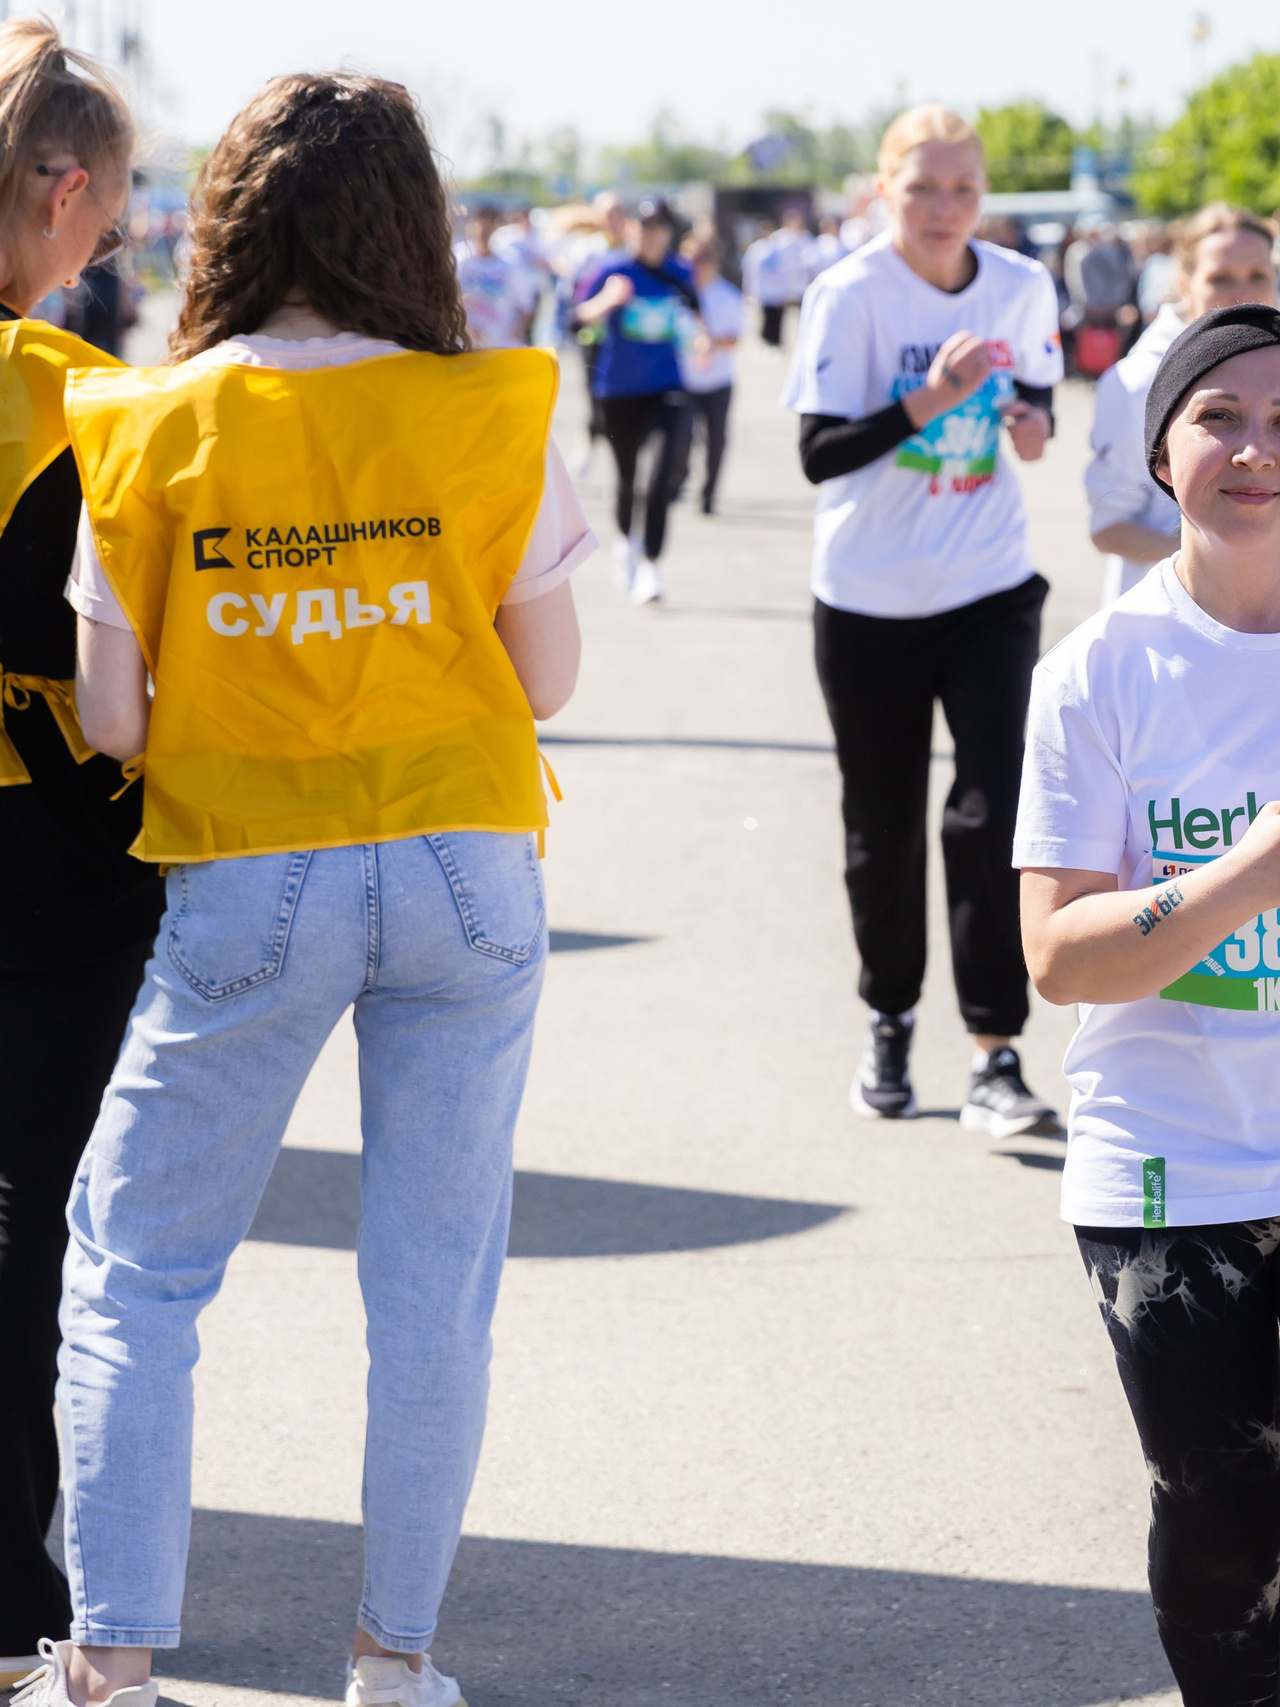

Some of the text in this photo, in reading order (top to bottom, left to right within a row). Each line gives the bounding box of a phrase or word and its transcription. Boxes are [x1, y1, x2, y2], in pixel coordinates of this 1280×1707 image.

[246, 517, 442, 547] КАЛАШНИКОВ
[247, 547, 337, 570] СПОРТ
[206, 580, 432, 645] СУДЬЯ
[1151, 1174, 1162, 1223] Herbalife
